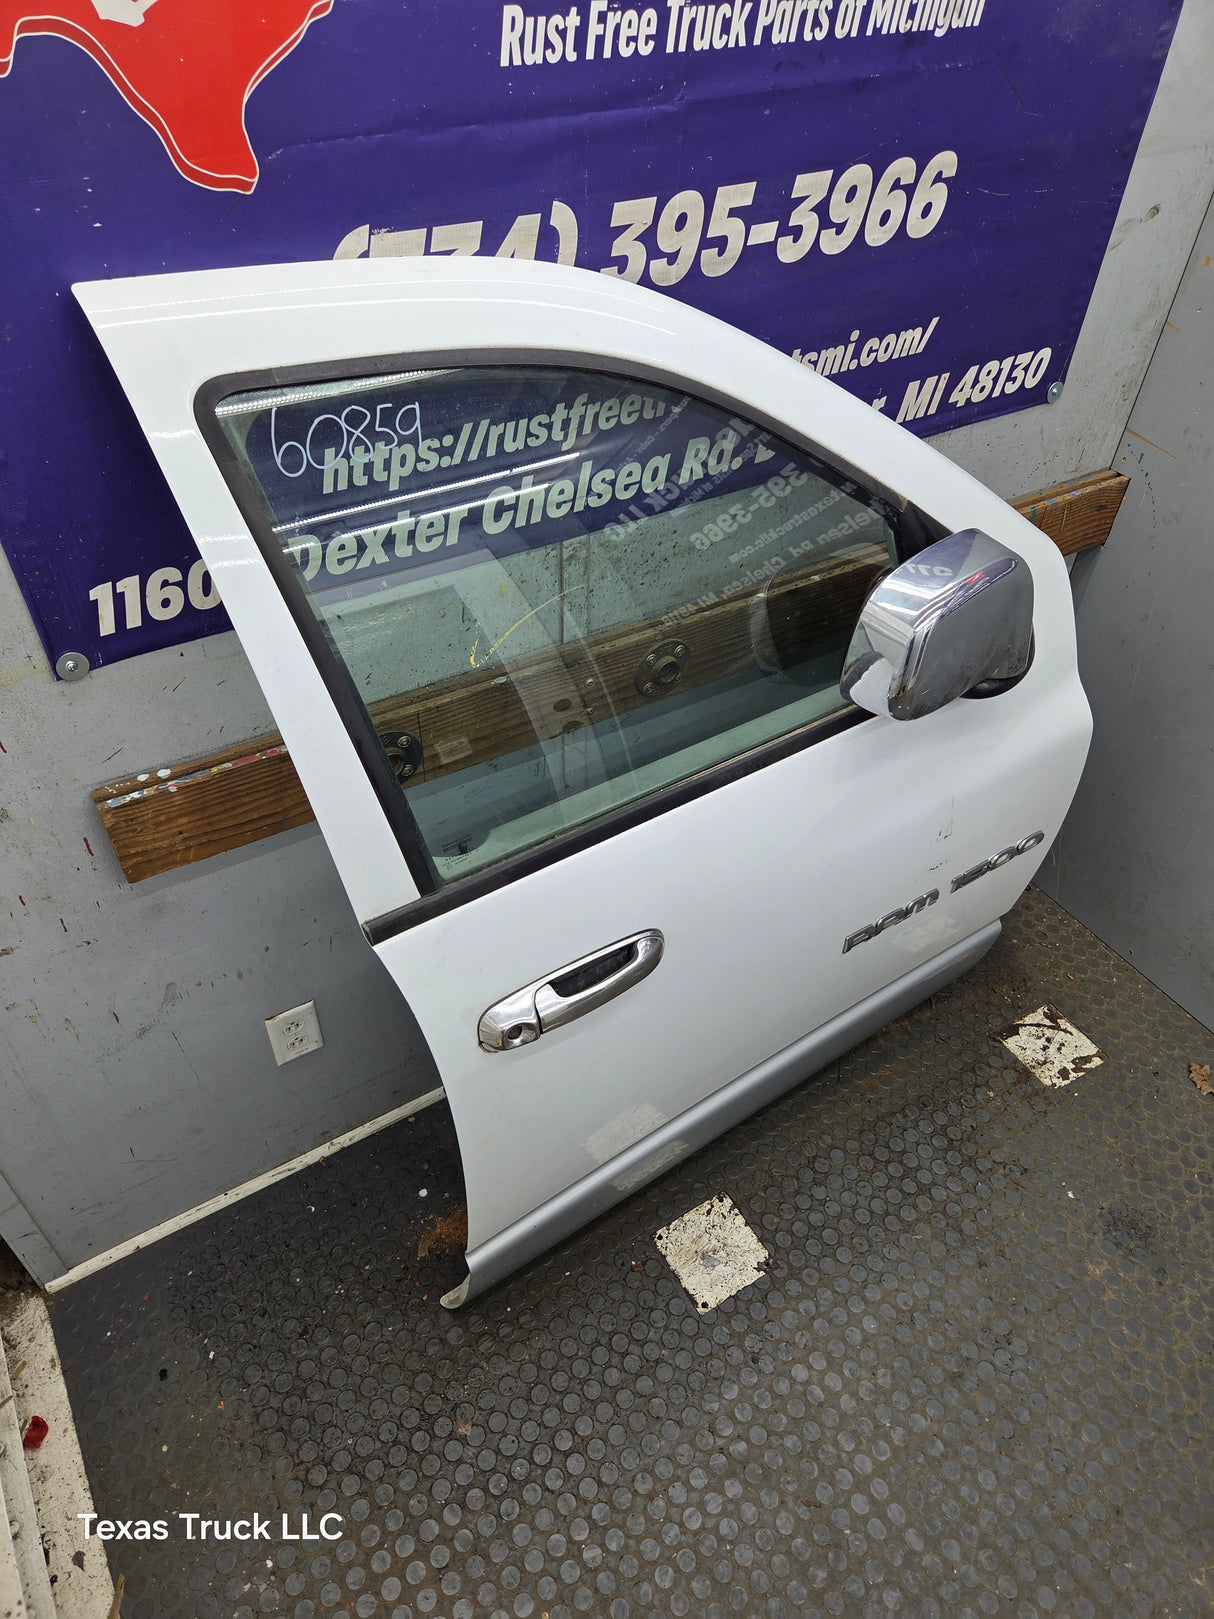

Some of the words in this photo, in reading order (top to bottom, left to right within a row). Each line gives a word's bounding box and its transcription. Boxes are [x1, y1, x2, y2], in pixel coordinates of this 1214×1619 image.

[500, 4, 580, 67] Rust
[586, 0, 658, 60] Free
[666, 0, 751, 53] Truck
[753, 0, 833, 45] Parts
[835, 0, 866, 39] of
[601, 150, 958, 287] 395-3966
[270, 401, 423, 478] 60859
[286, 507, 467, 582] Dexter
[482, 453, 671, 535] Chelsea
[679, 430, 743, 485] Rd.
[896, 372, 950, 423] MI
[948, 347, 1052, 408] 48130
[950, 830, 1045, 894] 1500
